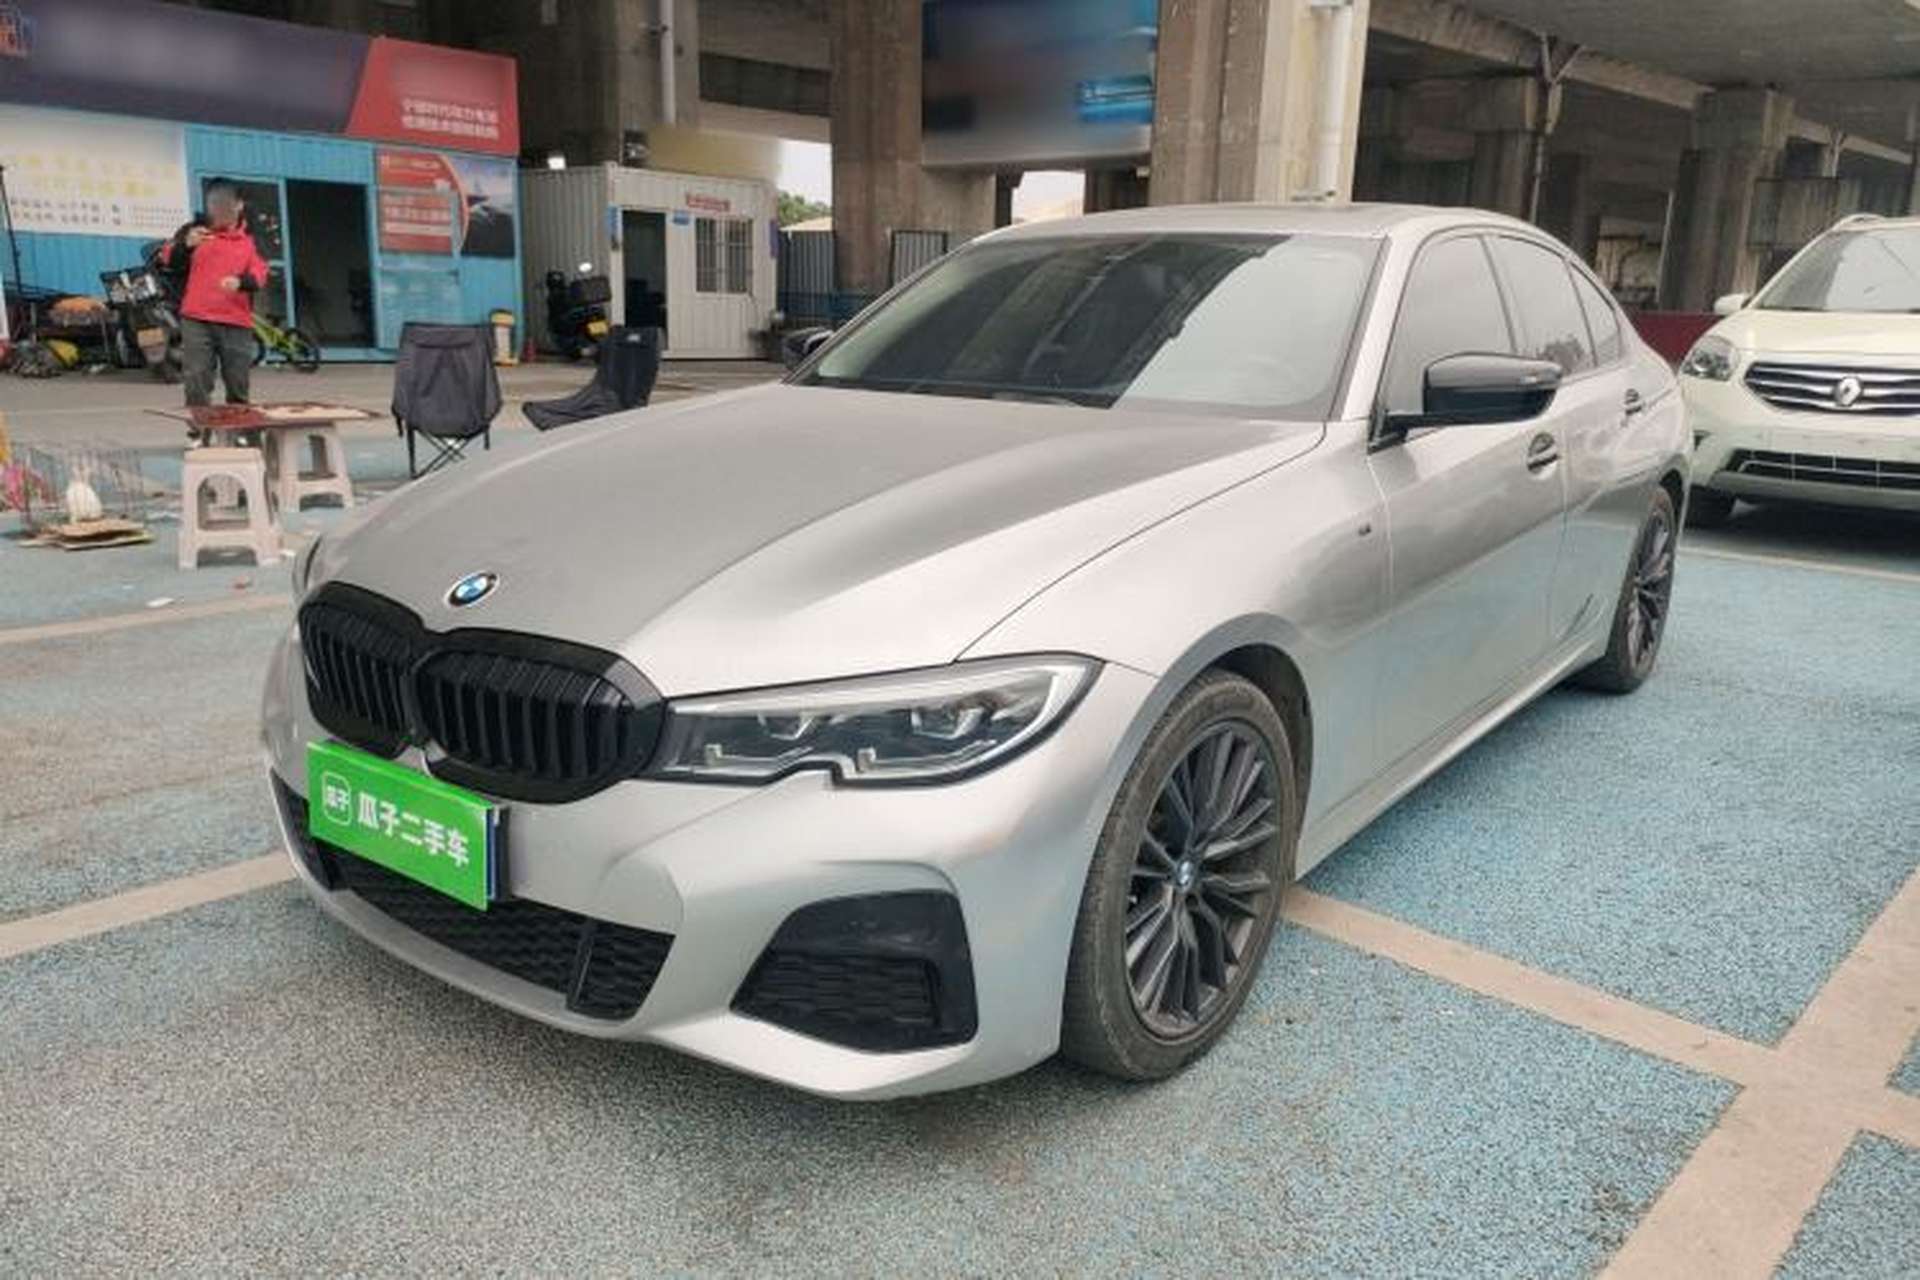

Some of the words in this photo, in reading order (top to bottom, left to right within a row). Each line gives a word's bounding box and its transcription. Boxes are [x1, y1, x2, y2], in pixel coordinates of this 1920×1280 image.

[358, 792, 469, 867] 瓜子二手车
